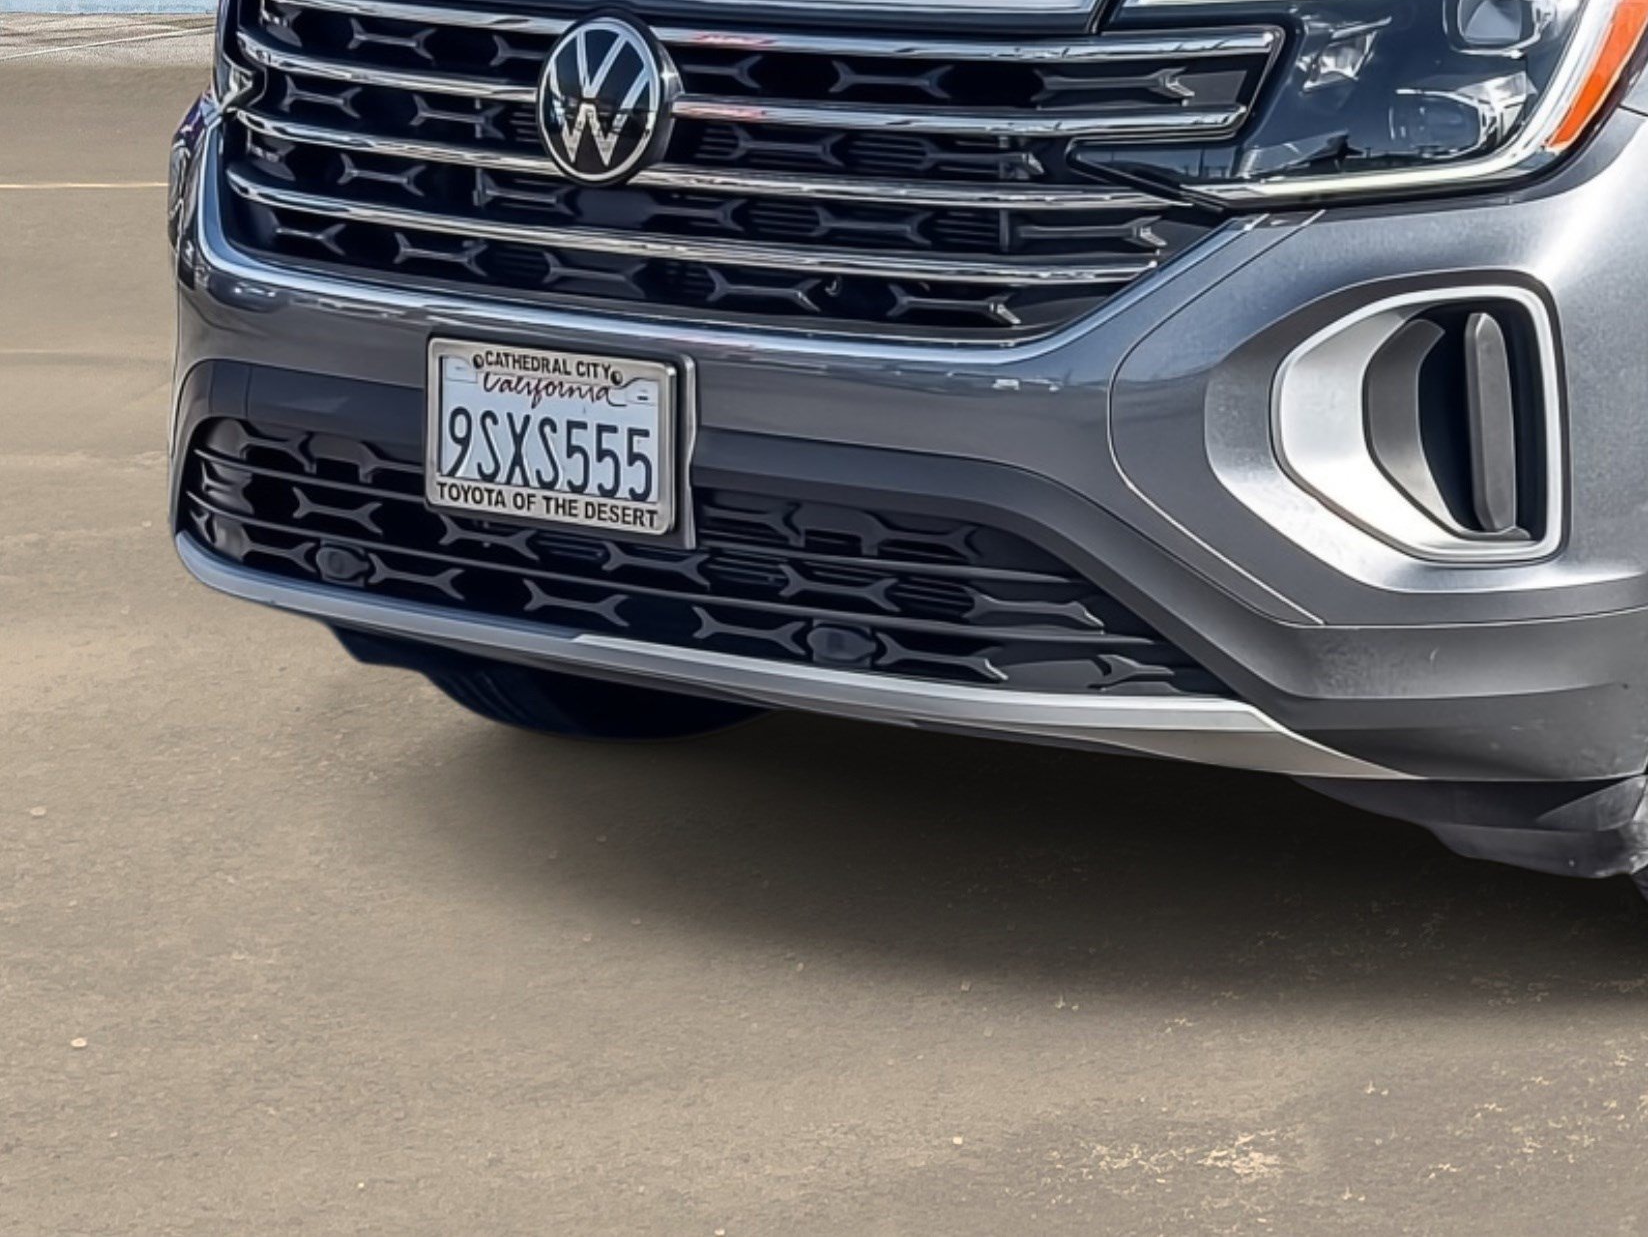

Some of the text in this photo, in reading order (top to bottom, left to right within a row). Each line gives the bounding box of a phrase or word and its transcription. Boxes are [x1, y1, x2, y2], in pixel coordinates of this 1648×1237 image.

[484, 350, 612, 380] CATHEDRAL CITY
[483, 372, 627, 409] California
[447, 406, 652, 502] 9SXS555
[437, 481, 659, 529] TOYOTA OF THE DESERT
